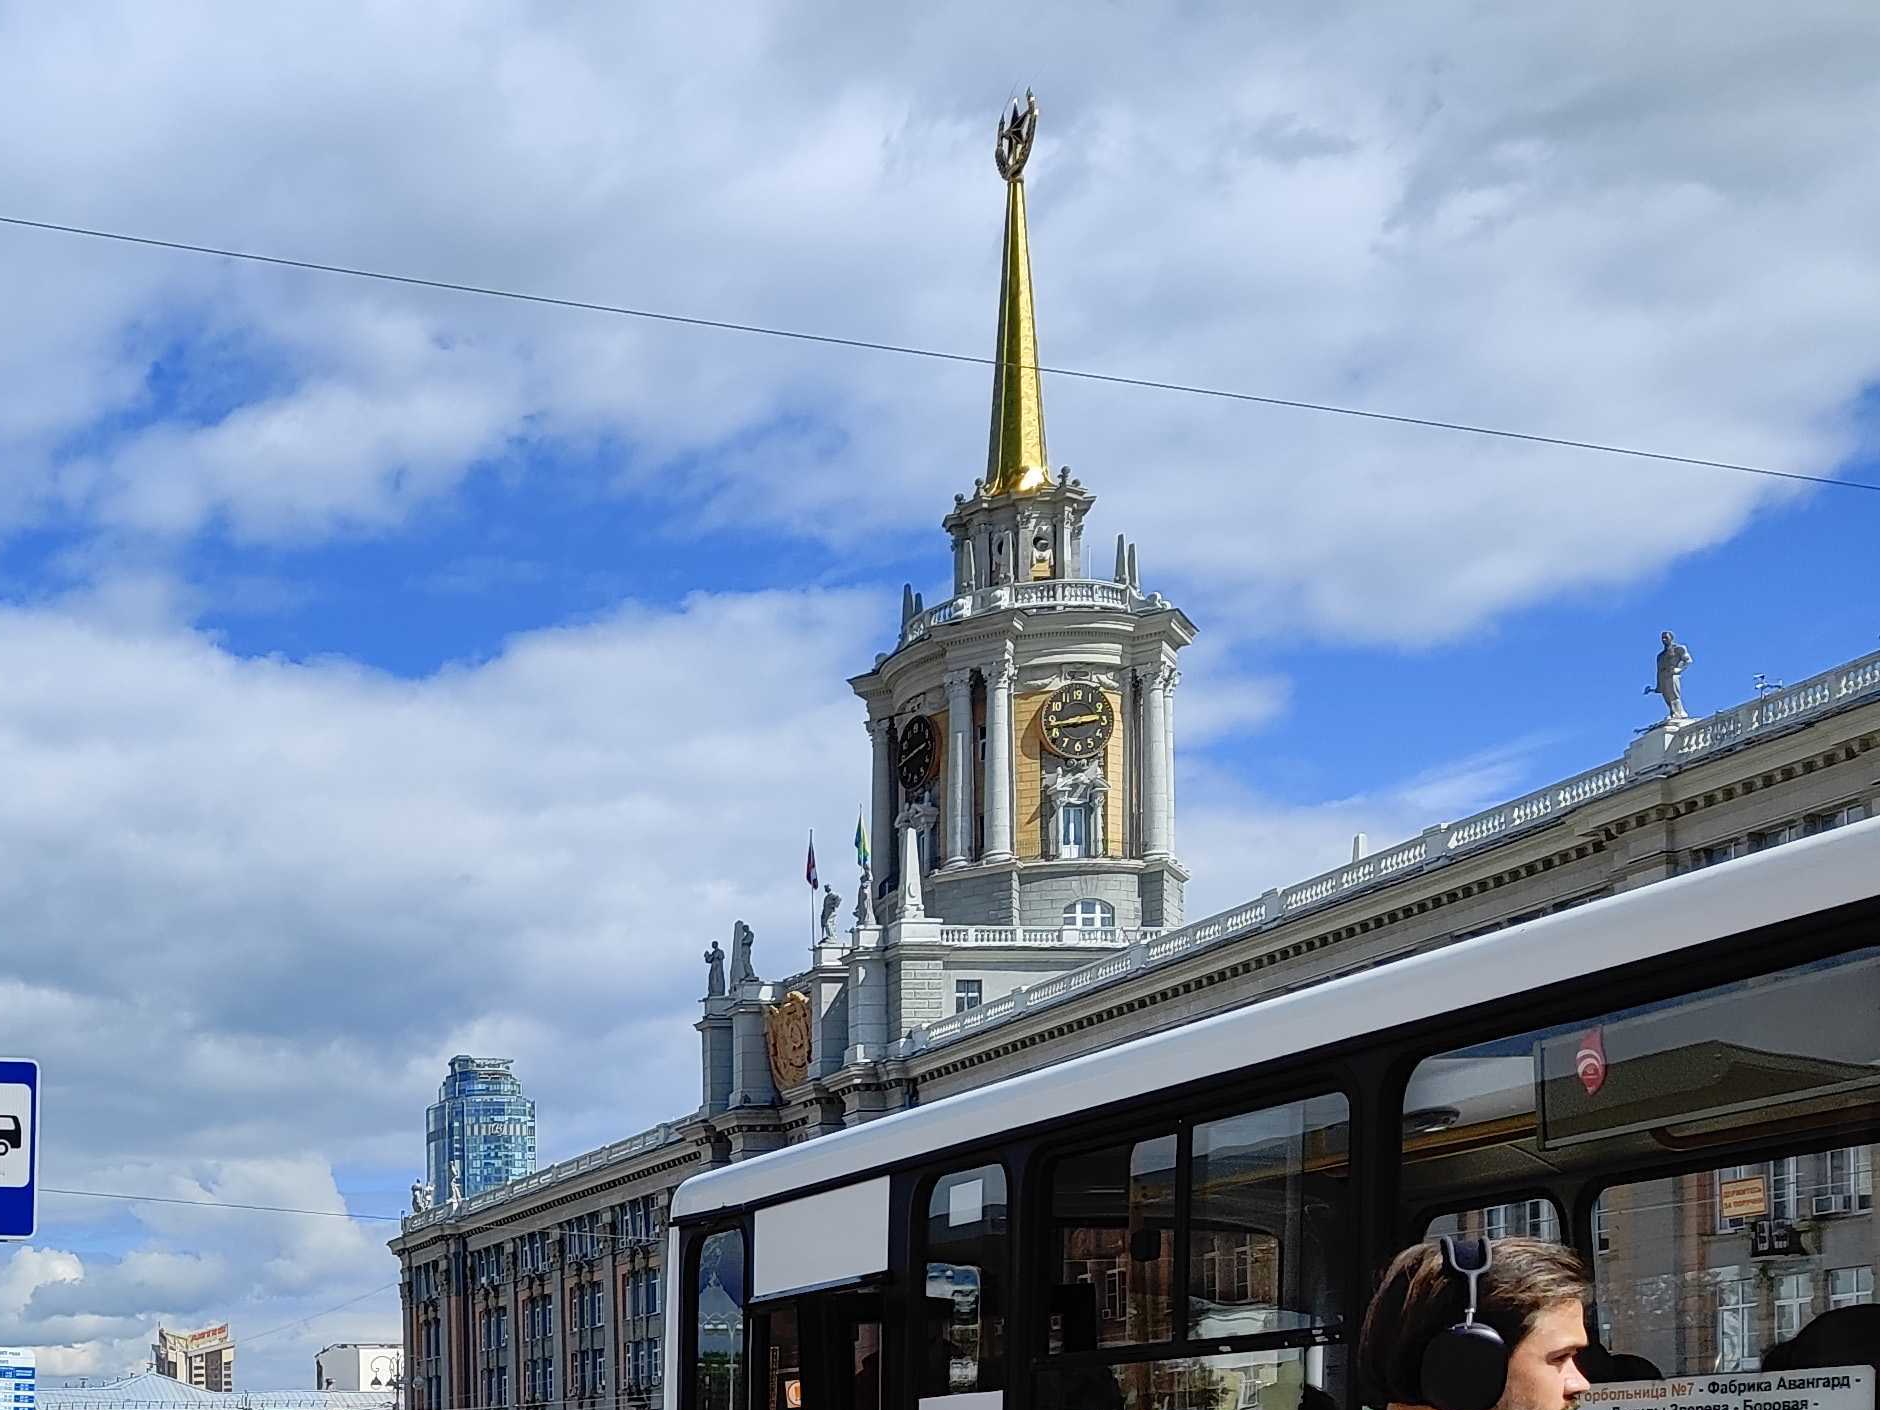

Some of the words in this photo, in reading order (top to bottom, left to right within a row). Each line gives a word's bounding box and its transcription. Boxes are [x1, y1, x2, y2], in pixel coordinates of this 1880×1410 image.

[1672, 1382, 1694, 1397] №7
[1707, 1375, 1771, 1396] Фабрика
[1776, 1376, 1850, 1390] Авангард
